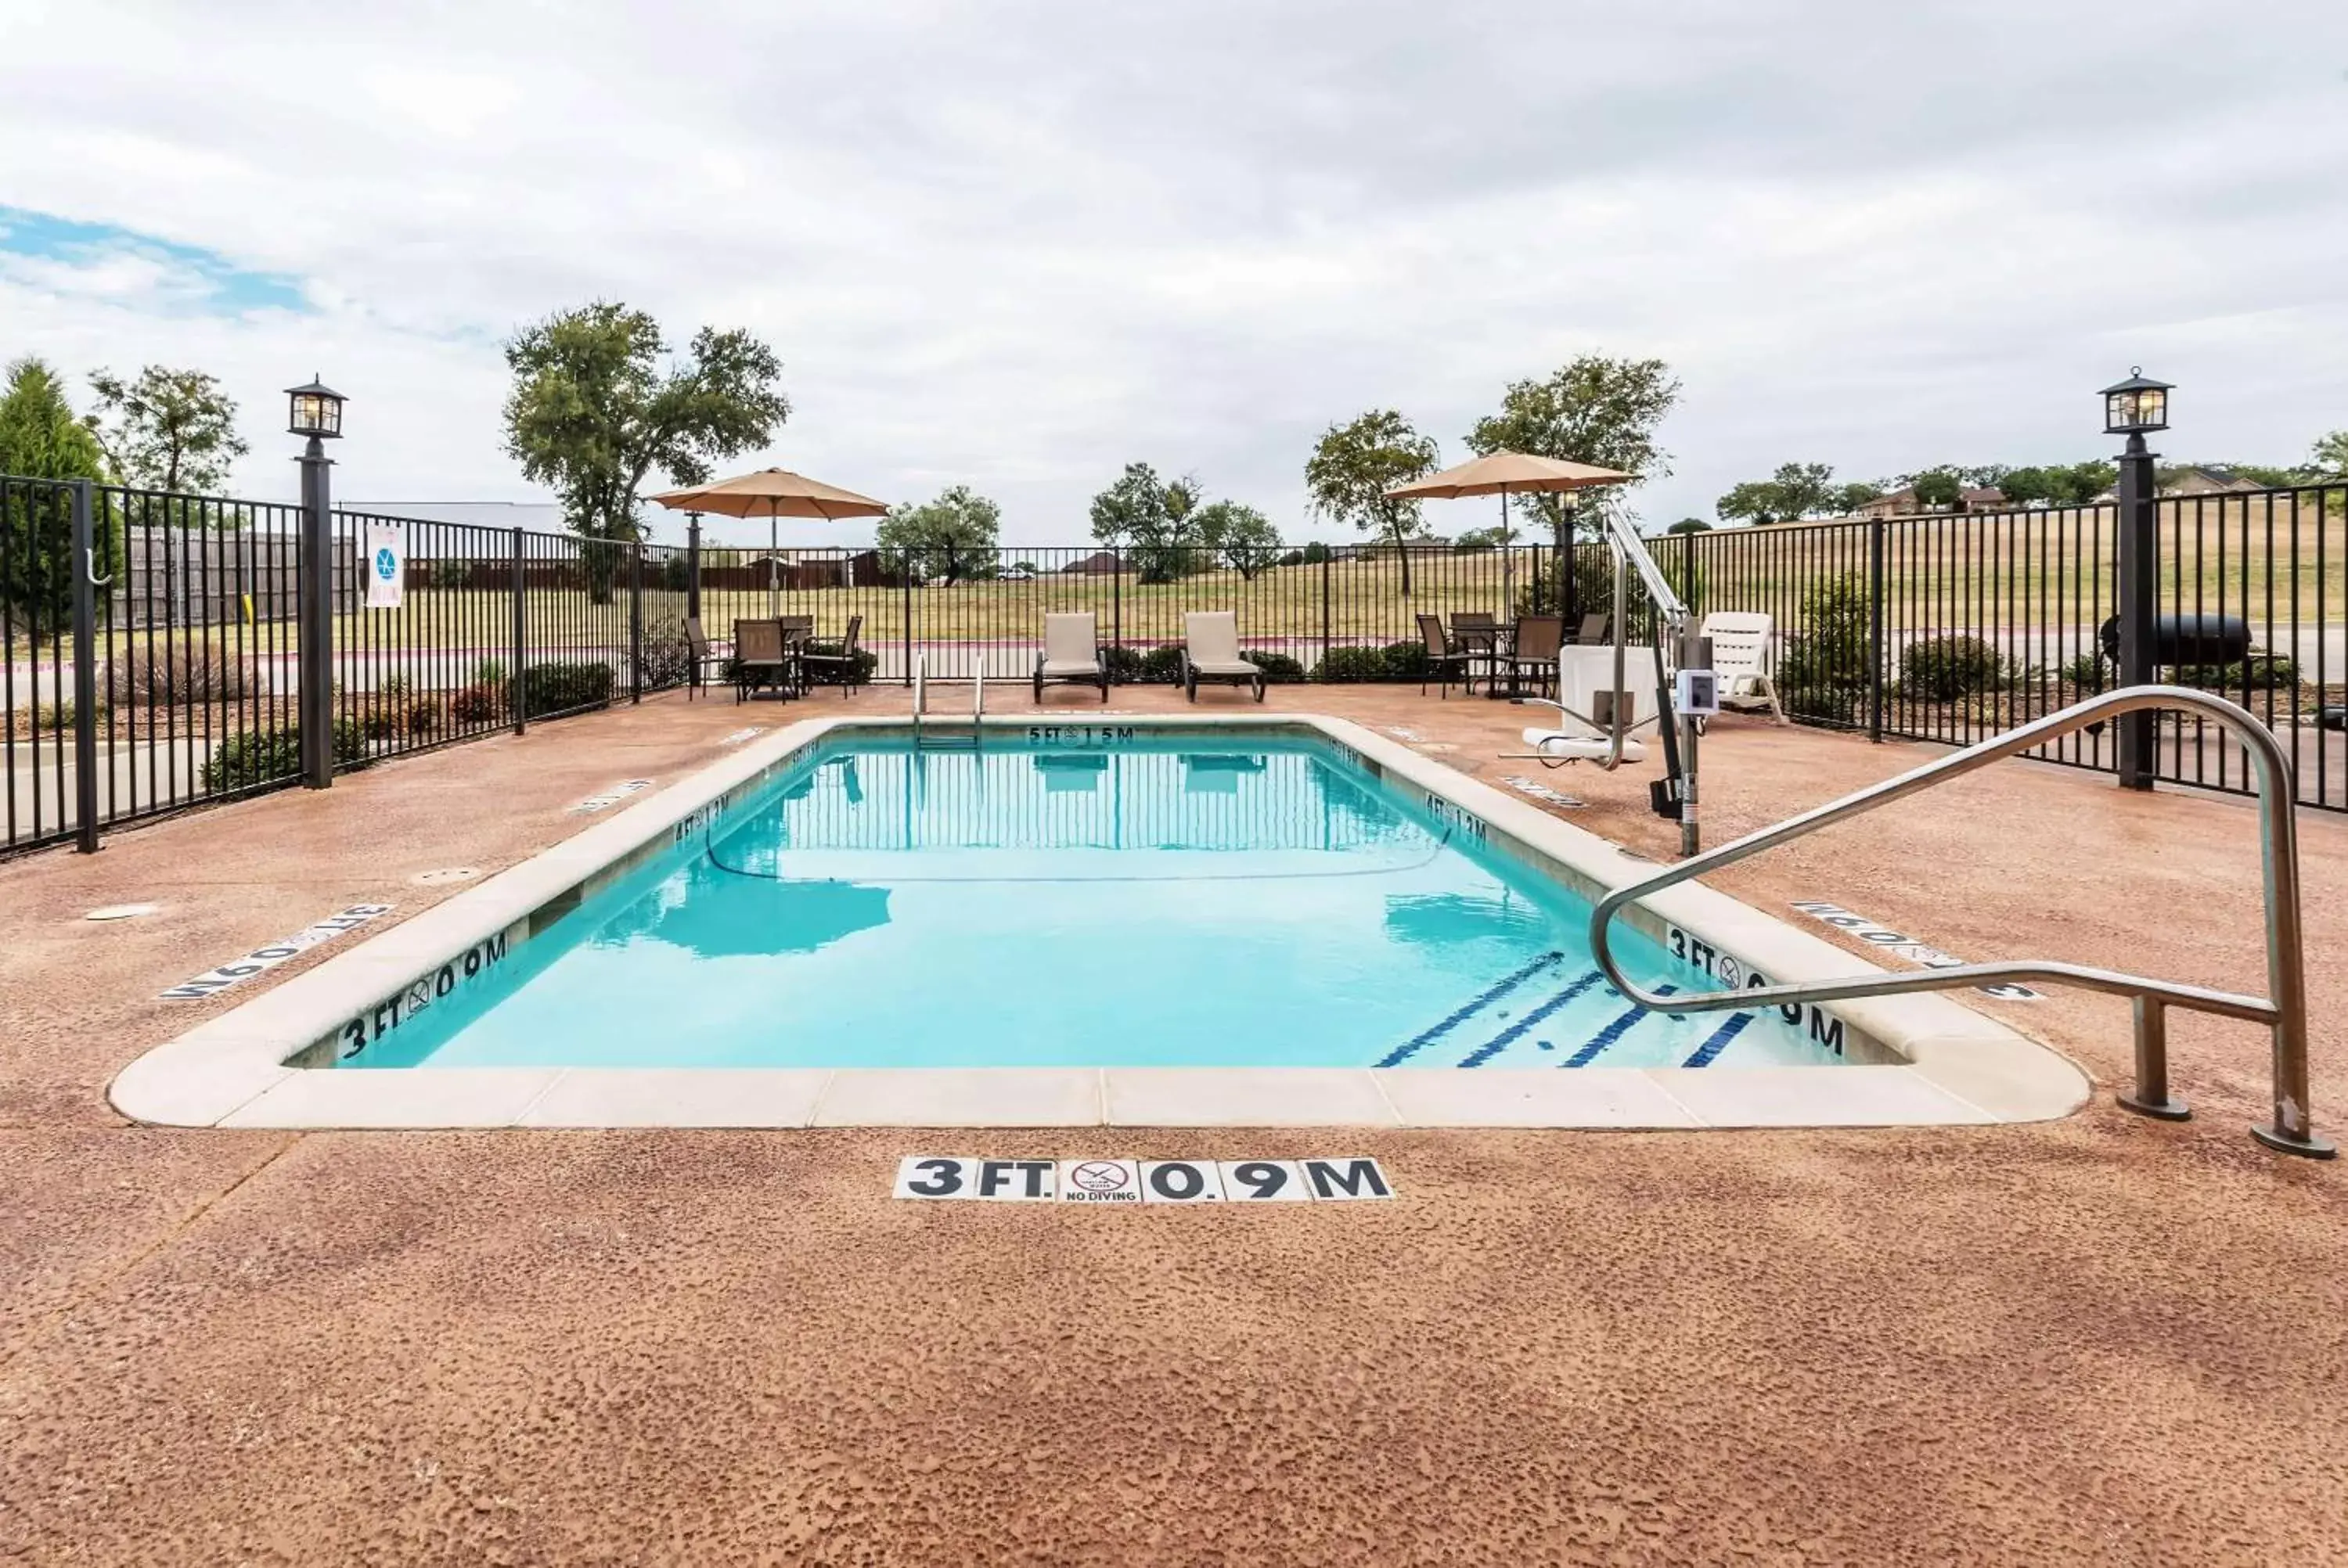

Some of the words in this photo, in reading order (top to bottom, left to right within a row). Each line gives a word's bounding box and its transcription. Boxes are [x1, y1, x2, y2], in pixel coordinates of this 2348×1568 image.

[342, 1019, 366, 1059] 3
[486, 932, 506, 968] M
[1670, 929, 1686, 959] 3
[1811, 1005, 1843, 1056] M
[908, 1159, 963, 1196] 3
[1066, 1192, 1086, 1201] NO
[1089, 1192, 1136, 1201] DIVING
[1305, 1160, 1389, 1198] M
